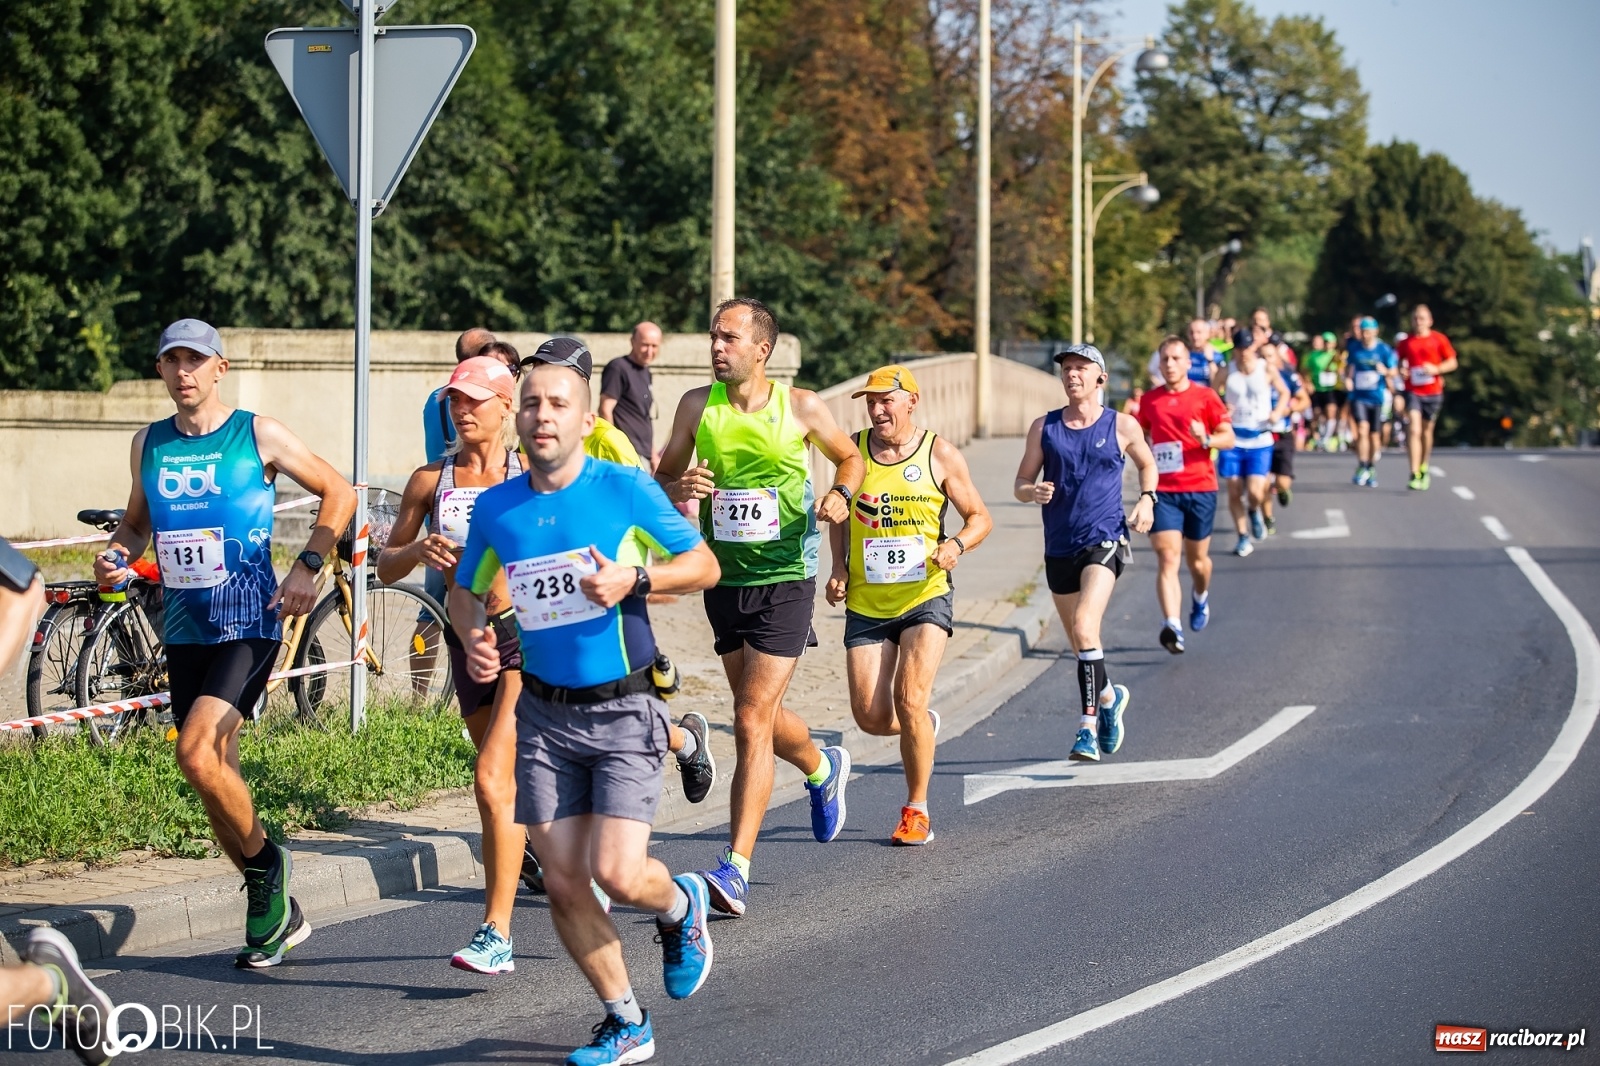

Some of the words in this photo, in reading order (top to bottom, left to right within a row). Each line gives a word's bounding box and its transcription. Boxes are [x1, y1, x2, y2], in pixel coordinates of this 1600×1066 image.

[158, 463, 222, 499] bbl
[170, 501, 209, 511] RACIBÓRZ
[880, 493, 931, 504] Gloucester
[728, 503, 762, 521] 276
[880, 505, 904, 516] City
[881, 517, 925, 528] Marathon
[173, 545, 204, 566] 131
[887, 549, 906, 564] 83
[533, 572, 576, 600] 238
